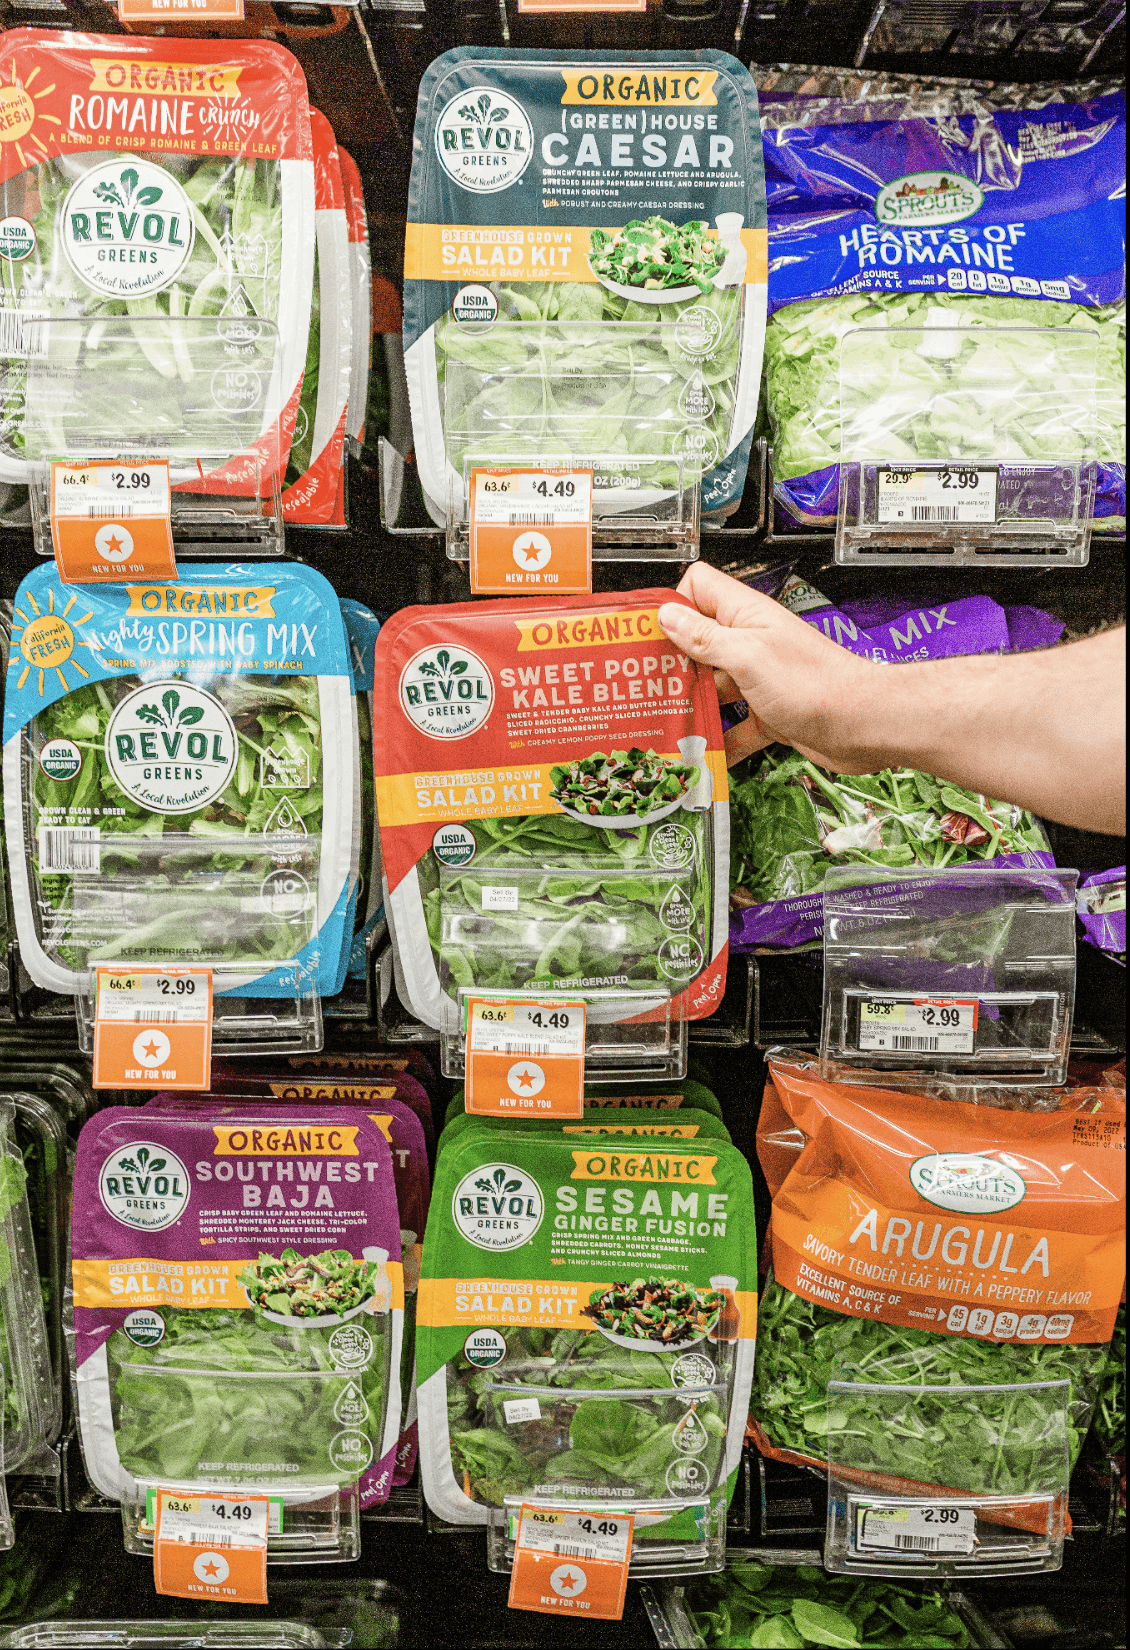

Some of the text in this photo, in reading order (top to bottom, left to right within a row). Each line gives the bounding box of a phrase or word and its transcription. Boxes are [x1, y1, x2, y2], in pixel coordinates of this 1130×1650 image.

[105, 64, 224, 93] ORGANIC
[578, 75, 700, 102] ORGANIC
[70, 94, 194, 135] ROMAINE
[561, 110, 718, 133] (GREEN)HOUSE
[49, 133, 276, 153] A BLEND OF CRISP ROMAINE & GREEN LEAF
[443, 128, 526, 152] REVOL
[542, 134, 734, 168] CAESAR
[463, 155, 507, 166] GREENS
[882, 192, 974, 220] SPROUTS
[3, 226, 27, 238] USDA
[71, 210, 184, 247] REVOL
[442, 230, 572, 243] GREENHOUSE GROWN
[839, 224, 1026, 256] HEARTS OF
[98, 249, 157, 264] GREENS
[442, 246, 572, 266] SALAD KIT
[858, 243, 1014, 271] ROMAINE
[863, 271, 899, 279] SOURCE
[463, 295, 488, 306] USDA
[459, 309, 491, 319] ORGANIC
[63, 472, 150, 489] 66.4¢ $2.99
[484, 480, 575, 498] 63.6¢ $4.49
[886, 472, 979, 489] 29.9¢ $2.99
[92, 564, 144, 574] NEW FOR YOU
[506, 573, 558, 583] NEW FOR YOU
[142, 590, 259, 614] ORGANIC
[25, 623, 66, 645] California
[532, 615, 653, 646] ORGANIC
[889, 606, 956, 650] MIX
[87, 619, 318, 657] Mighty SPRING MIX
[30, 636, 70, 661] FRESH
[501, 654, 691, 688] SWEET POPPY
[406, 679, 488, 705] REVOL
[513, 677, 683, 709] KALE BLEND
[428, 705, 471, 717] GREENS
[629, 701, 657, 709] BUTTER
[659, 699, 693, 707] LETTUCE,
[49, 749, 73, 758] USDA
[115, 731, 228, 764] REVOL
[46, 761, 76, 769] ORGANIC
[143, 767, 202, 780] GREENS
[415, 770, 540, 788] GREENHOUSE GROWN
[417, 783, 542, 808] SALAD KIT
[438, 804, 523, 817] WHOLE BABY LEAF
[442, 835, 466, 844] USDA
[439, 846, 471, 855] ORGANIC
[110, 980, 195, 994] 66.4¢ $2.99
[524, 975, 628, 990] KEEP REFRIGERATED
[481, 1011, 569, 1029] 63.6¢ $4.49
[922, 1008, 960, 1026] $2.99
[125, 1070, 176, 1080] NEW FOR YOU
[500, 1099, 551, 1108] NEW FOR YOU
[229, 1130, 343, 1152] ORGANIC
[196, 1162, 379, 1182] SOUTHWEST
[587, 1156, 700, 1179] ORGANIC
[106, 1177, 183, 1197] REVOL
[126, 1200, 165, 1210] GREENS
[243, 1186, 335, 1208] BAJA
[556, 1185, 729, 1219] SESAME
[460, 1197, 537, 1218] REVOL
[478, 1220, 519, 1229] GREENS
[554, 1215, 726, 1237] GINGER FUSION
[849, 1209, 1049, 1277] ARUGULA
[109, 1265, 228, 1276] GREENHOUSE GROWN
[803, 1234, 1091, 1305] SAVORY TENDER LEAF WITH A PEPPERY FLAVOR
[109, 1276, 229, 1295] SALAD KIT
[456, 1283, 577, 1295] GREENHOUSE GROWN
[800, 1264, 901, 1305] EXCELLENT SOURCE OF
[796, 1276, 882, 1314] VITAMINS A, C & K
[456, 1296, 576, 1315] SALAD KIT
[132, 1318, 156, 1327] USDA
[130, 1328, 159, 1337] ORGANIC
[474, 1338, 497, 1347] USDA
[470, 1349, 500, 1358] ORGANIC
[534, 1485, 635, 1497] KEEP REFRIGERATED
[168, 1501, 251, 1520] 63.6¢ $4.49
[920, 1510, 959, 1524] $2.99
[533, 1513, 618, 1536] 63.6¢ $4.49
[188, 1584, 236, 1595] NEW FOR YOU
[540, 1596, 591, 1609] NEW FOR YOU
